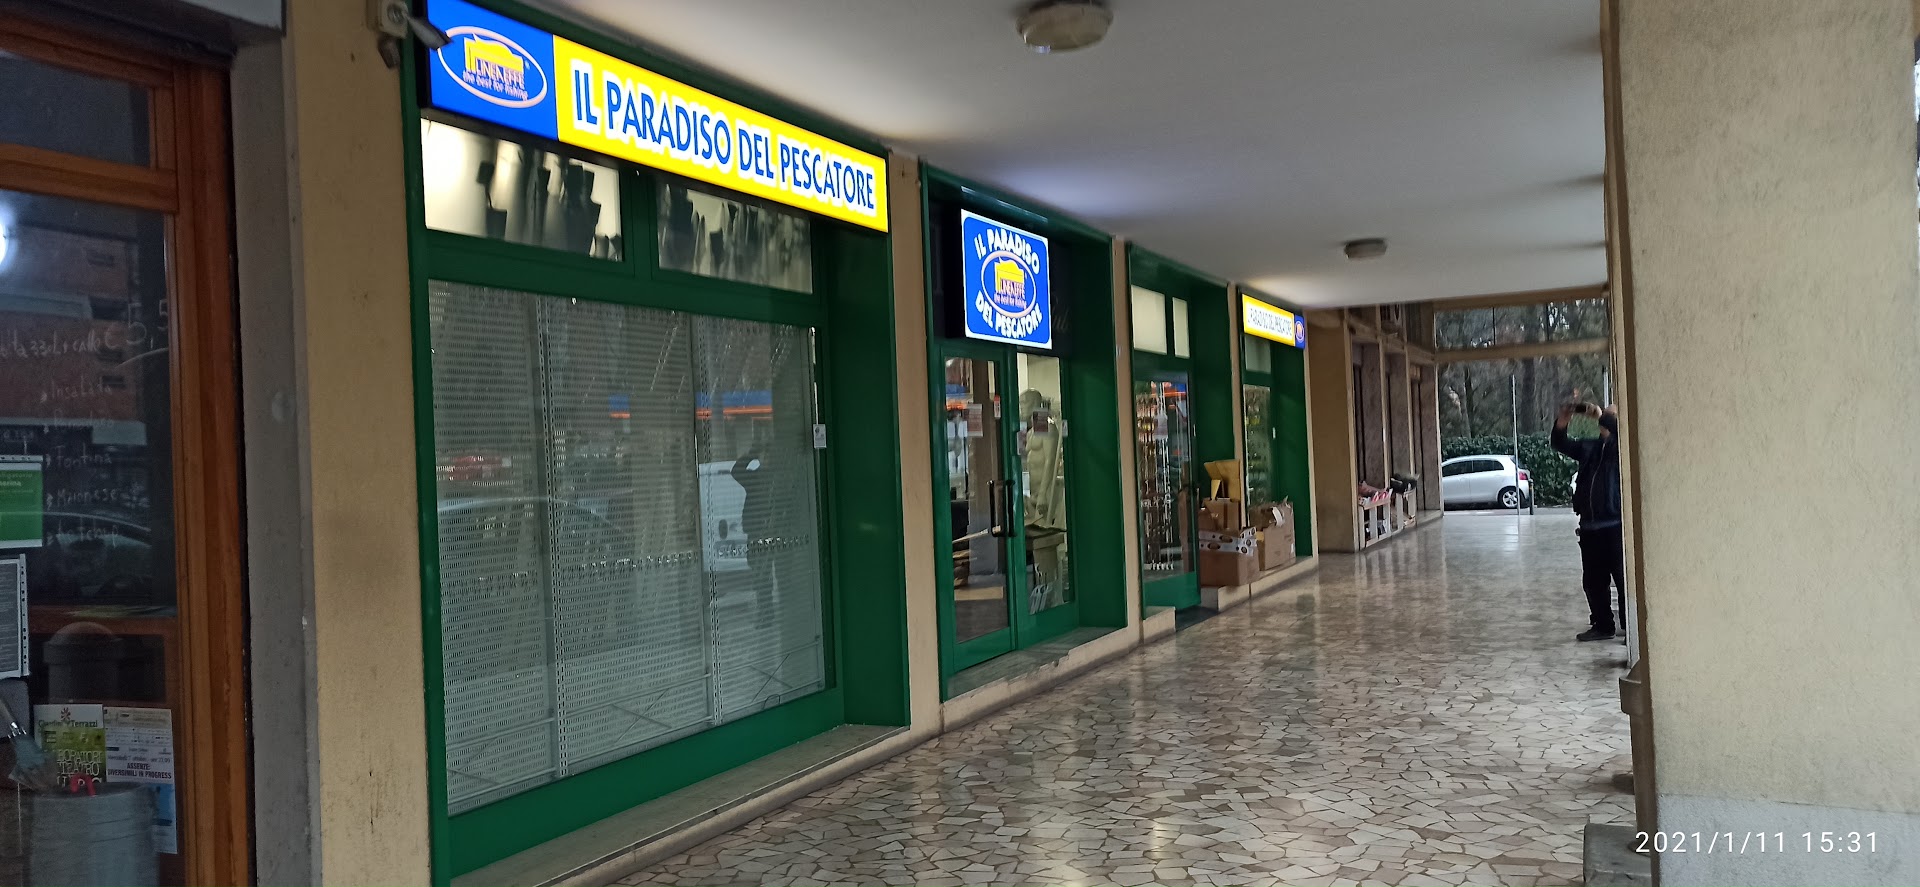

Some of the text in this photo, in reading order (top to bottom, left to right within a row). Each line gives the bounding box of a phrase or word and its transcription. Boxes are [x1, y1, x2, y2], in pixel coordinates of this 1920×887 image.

[574, 69, 875, 210] IL PARADISO DEL PESCATORE
[974, 228, 1040, 275] IL PARADISO
[975, 290, 993, 328] DEL
[995, 303, 1043, 338] PESCATORE
[71, 719, 98, 728] Terrazzi
[145, 771, 172, 780] PROGRESS
